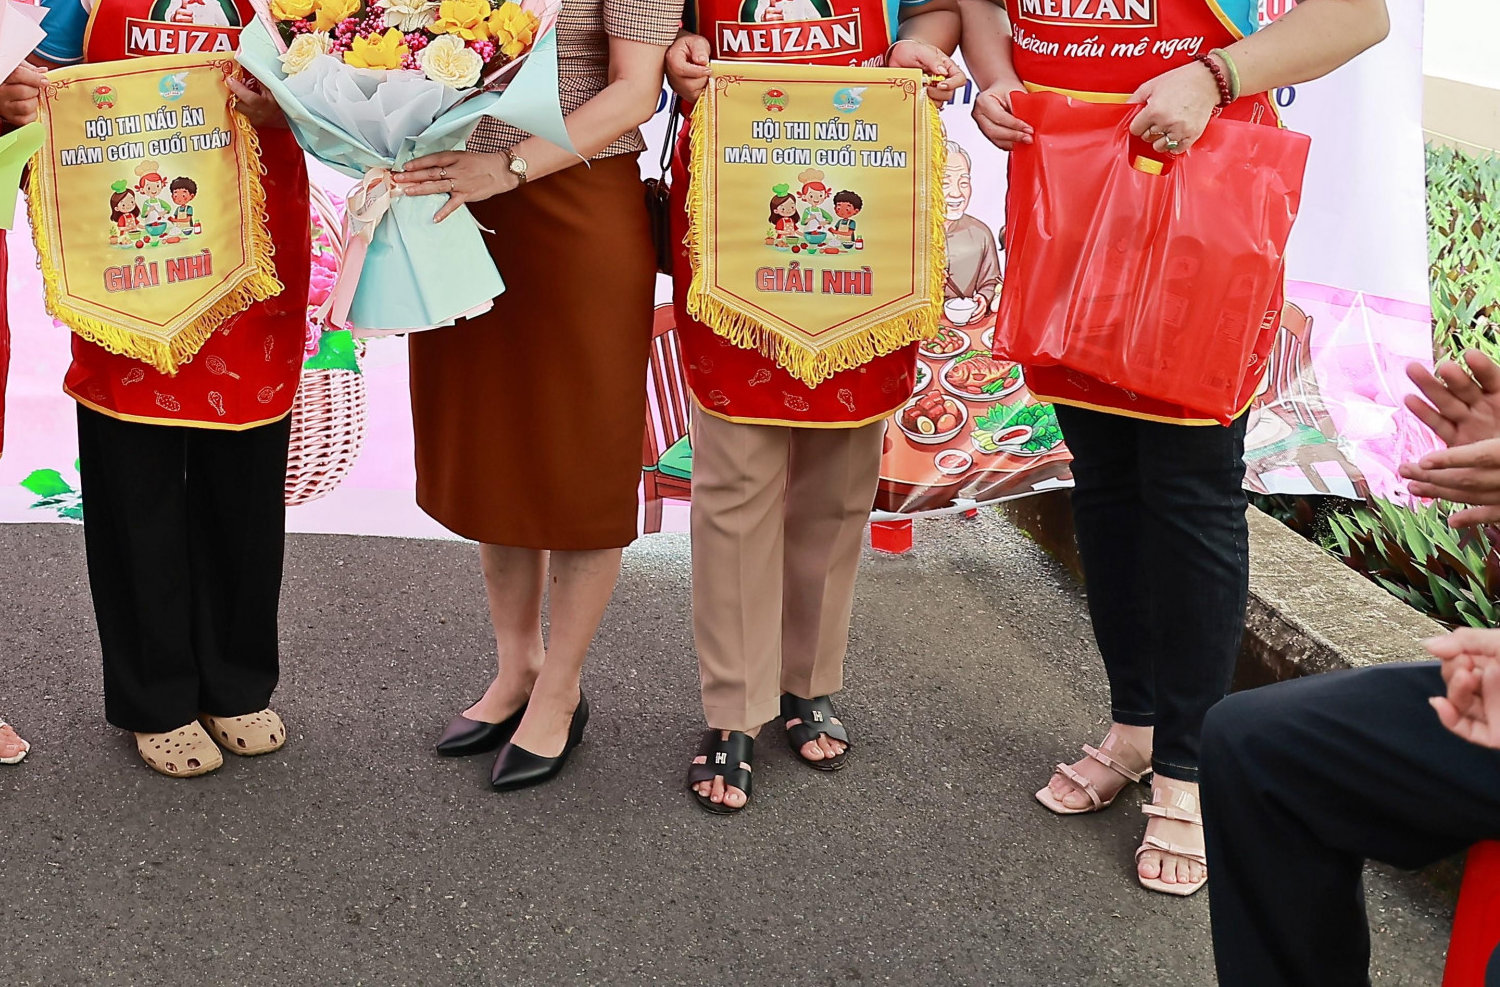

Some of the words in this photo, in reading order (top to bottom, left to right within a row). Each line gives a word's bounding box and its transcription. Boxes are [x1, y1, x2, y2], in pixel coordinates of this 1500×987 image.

[130, 26, 241, 54] MEIZA
[722, 21, 859, 54] MEIZAN
[1063, 35, 1105, 58] nấu
[1110, 36, 1150, 57] mê
[1152, 36, 1204, 59] ngay
[85, 115, 114, 140] HỘI
[117, 113, 142, 136] THI
[145, 106, 181, 135] NẤU
[182, 105, 205, 129] ĂN
[752, 119, 781, 143] HỘI
[784, 121, 813, 143] THI
[815, 115, 852, 144] NẤU
[854, 118, 878, 143] ĂN
[61, 141, 105, 167] MÂM
[108, 142, 145, 164] CƠM
[148, 132, 188, 158] CUỐI
[190, 125, 232, 152] TUẦN
[724, 143, 770, 166] MÂM
[772, 146, 812, 166] CƠM
[815, 142, 856, 168] CUỐI
[860, 143, 907, 169] TUẦN
[103, 257, 161, 294] GIẢI
[166, 247, 214, 285] NHÌ
[755, 261, 814, 295] GIẢI
[821, 265, 875, 297] NHÌ
